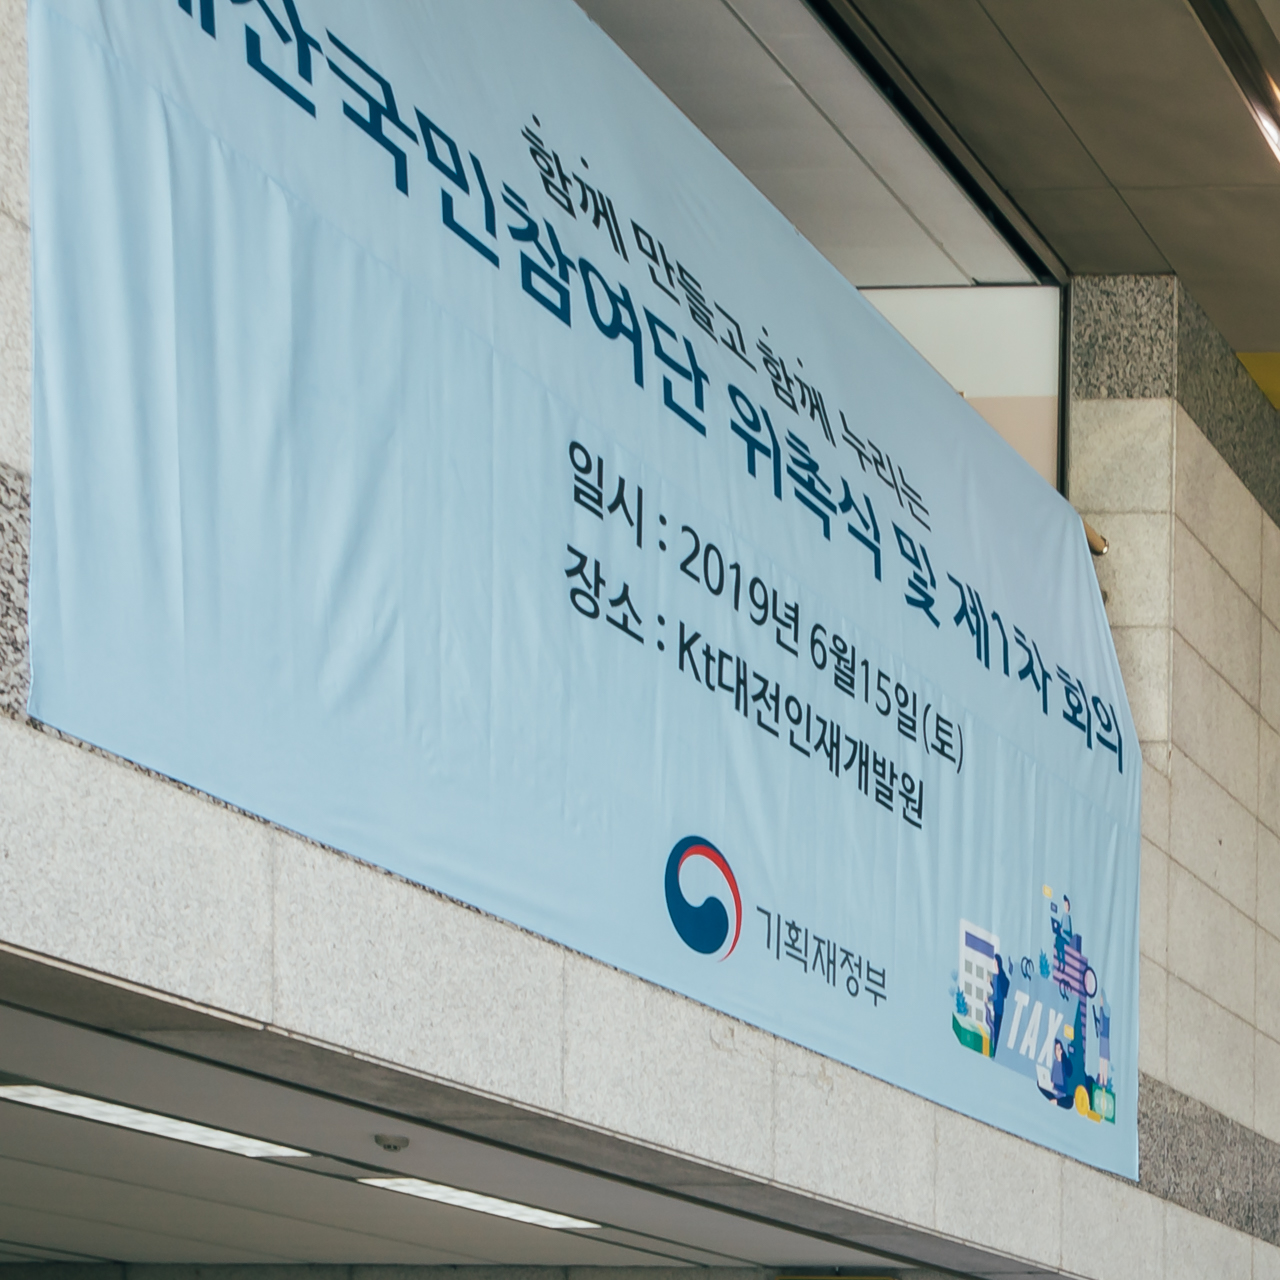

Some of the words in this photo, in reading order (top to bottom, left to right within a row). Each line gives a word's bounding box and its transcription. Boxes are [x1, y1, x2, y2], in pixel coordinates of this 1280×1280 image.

[178, 0, 711, 438] 산국민참여단
[726, 383, 882, 582] 위촉식
[891, 520, 941, 629] 및
[946, 571, 1053, 716] 제1차
[1055, 663, 1124, 775] 회의
[521, 114, 629, 263] 함께
[630, 218, 758, 373] 만들고
[756, 326, 836, 448] 함께
[838, 409, 932, 533] 누리는
[564, 543, 645, 645] 장소
[678, 619, 925, 830] Kt대전인재개발원
[567, 440, 644, 549] 일시
[679, 525, 800, 658] 2019년
[809, 622, 964, 775] 6월15일(토)
[756, 904, 888, 1008] 기획재정부
[1005, 989, 1065, 1069] TAX
